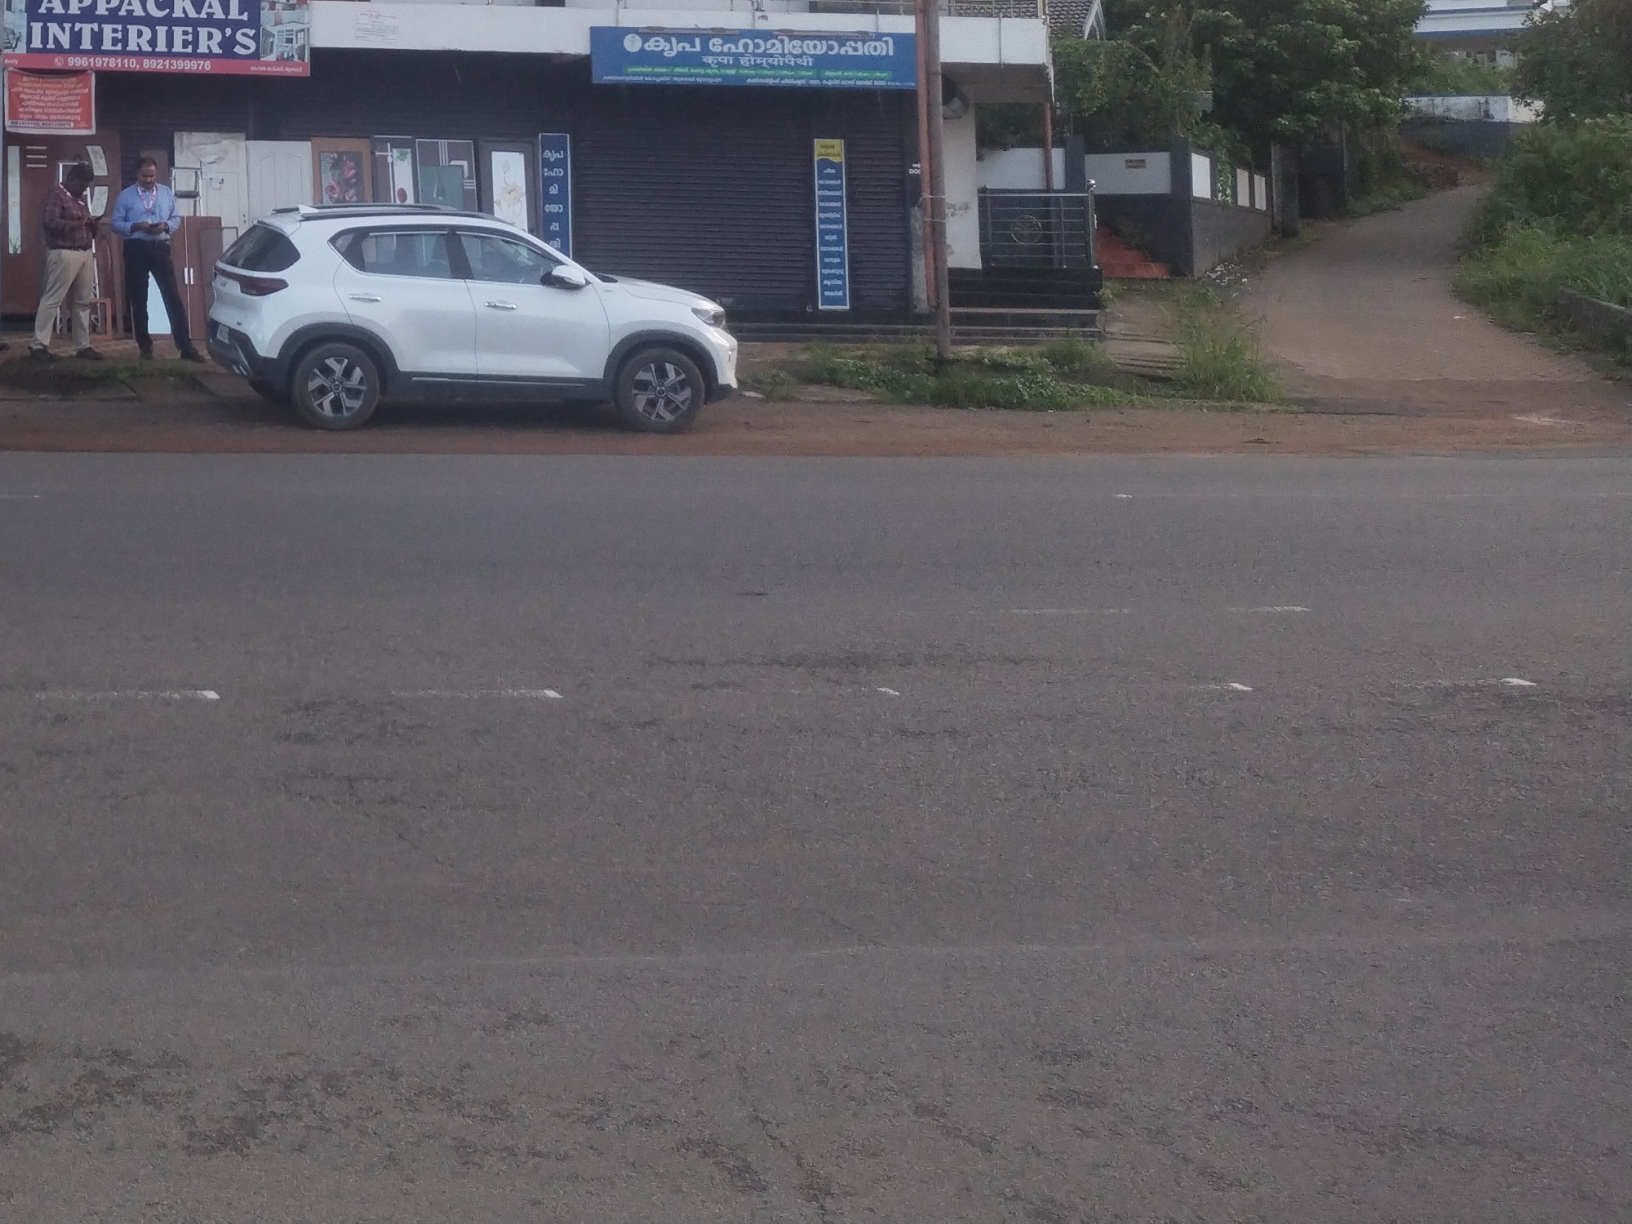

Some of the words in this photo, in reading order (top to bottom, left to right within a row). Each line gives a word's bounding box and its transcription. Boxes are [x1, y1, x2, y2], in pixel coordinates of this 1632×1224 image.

[29, 21, 258, 55] INTERIER'S
[643, 36, 701, 57] കൃപ
[708, 36, 894, 56] ഹോമിയോപ്പതി
[67, 56, 140, 70] 9961978110,
[142, 58, 212, 71] 8921399976
[542, 150, 564, 162] കൃപ
